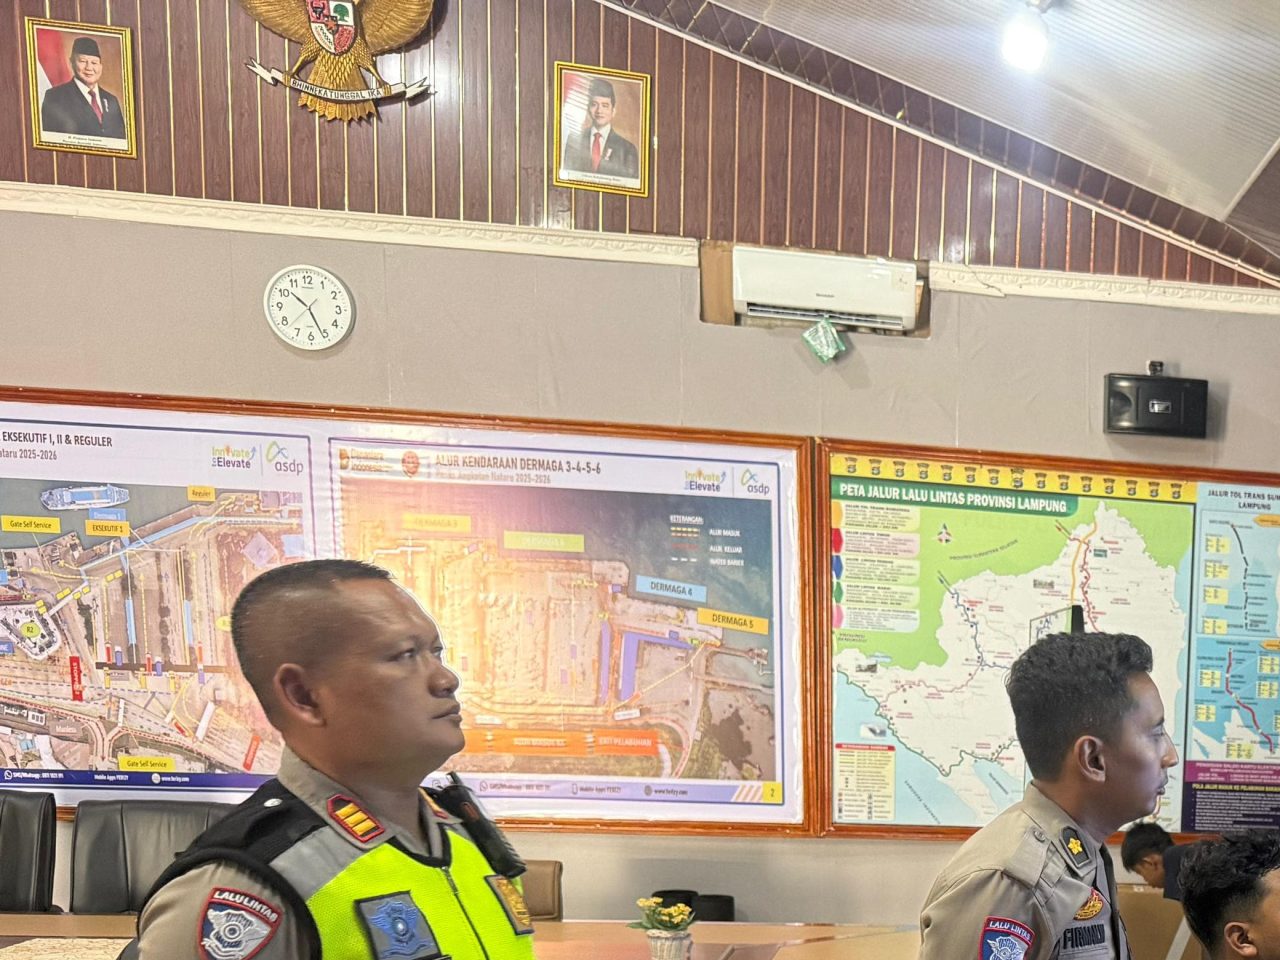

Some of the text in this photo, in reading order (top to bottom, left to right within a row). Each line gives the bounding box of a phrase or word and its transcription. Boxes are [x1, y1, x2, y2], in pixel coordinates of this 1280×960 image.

[368, 89, 382, 98] IKA
[290, 278, 298, 288] 11
[302, 275, 313, 285] 12
[320, 280, 325, 290] 1
[278, 288, 290, 298] 10
[330, 291, 337, 300] 2
[276, 302, 283, 311] 9
[335, 305, 342, 315] 3
[281, 316, 289, 326] 8
[331, 319, 339, 329] 4
[294, 327, 301, 337] 7
[308, 332, 315, 341] 6
[322, 329, 329, 339] 5
[2, 431, 47, 443] EKSEKUTIF
[65, 434, 72, 444] &
[74, 435, 113, 447] REGULER
[19, 449, 57, 460] 2025-2026
[217, 457, 251, 469] Elevate
[274, 459, 304, 476] asdp
[436, 455, 601, 474] ALUR KENDARAAN DERMAGA 3-4-5-6
[690, 480, 721, 492] Elevate
[747, 483, 770, 496] asdp
[840, 483, 1067, 513] PETA JALUR LALU LINTAS PROVINSI LAMPUNG
[1208, 489, 1228, 498] JALUR
[1244, 492, 1265, 500] TRANS
[1238, 502, 1271, 510] LAMPUNG
[10, 520, 23, 528] Gate
[33, 521, 52, 529] Service
[650, 581, 687, 595] DERMAGA
[712, 613, 748, 627] DERMAGA
[213, 890, 279, 922] LALU LINTAS
[989, 921, 1031, 941] LALU LINTAS
